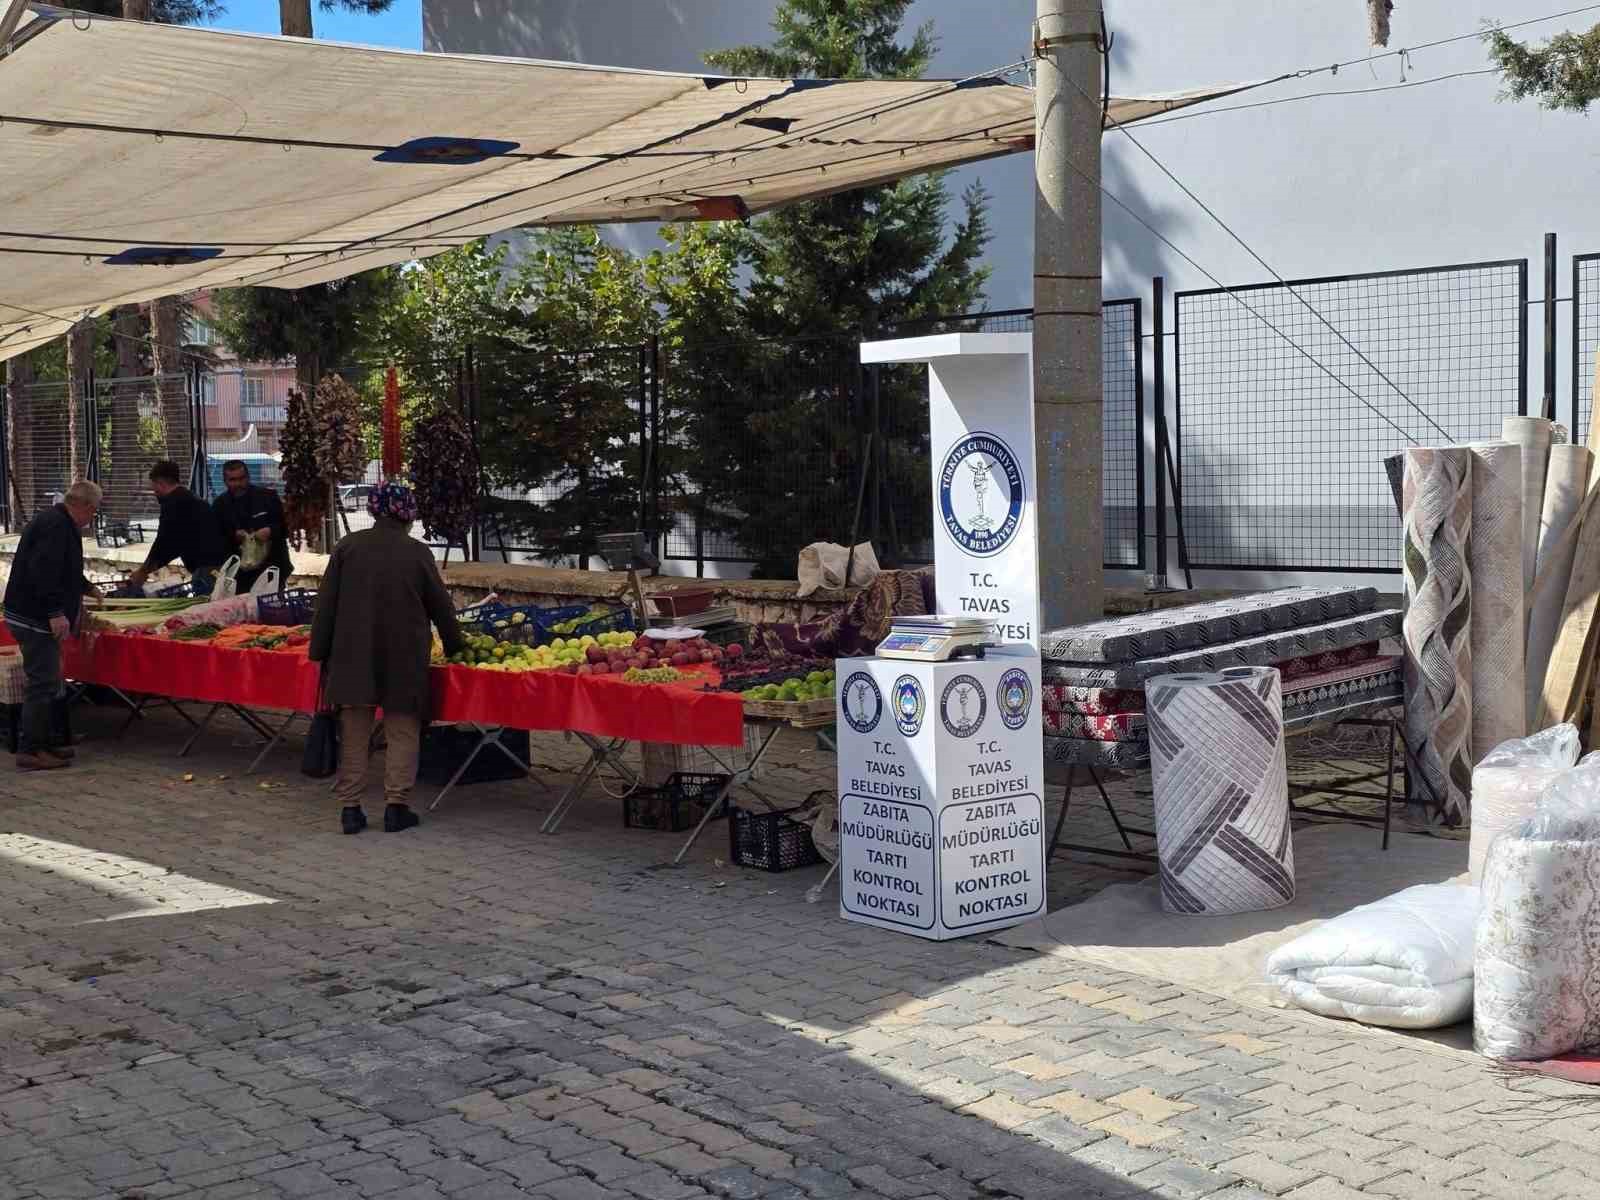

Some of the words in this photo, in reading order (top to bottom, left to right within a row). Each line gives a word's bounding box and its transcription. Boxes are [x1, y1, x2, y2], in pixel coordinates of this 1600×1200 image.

[946, 513, 969, 545] TAVAS
[969, 514, 1018, 551] BELEDİYESİ
[969, 573, 998, 588] T.C.
[960, 597, 1010, 613] TAVAS
[873, 742, 896, 755] T.C.
[977, 741, 1001, 754] T.C.
[865, 760, 905, 777] TAVAS
[968, 760, 1012, 777] TAVAS
[851, 779, 921, 800] BELEDİYESİ
[952, 776, 1028, 800] BELEDİYESİ
[863, 802, 909, 822] ZABITA
[965, 802, 1016, 821] ZABITA
[843, 821, 932, 850] MÜDÜRLÜĞÜ
[942, 819, 1040, 850] MÜDÜRLÜĞÜ
[866, 849, 907, 869] TARTI
[970, 849, 1014, 868] TARTI
[854, 869, 923, 895] KONTROL
[955, 869, 1031, 895] KONTROL
[857, 892, 919, 918] NOKTASI
[959, 893, 1028, 917] NOKTASI
